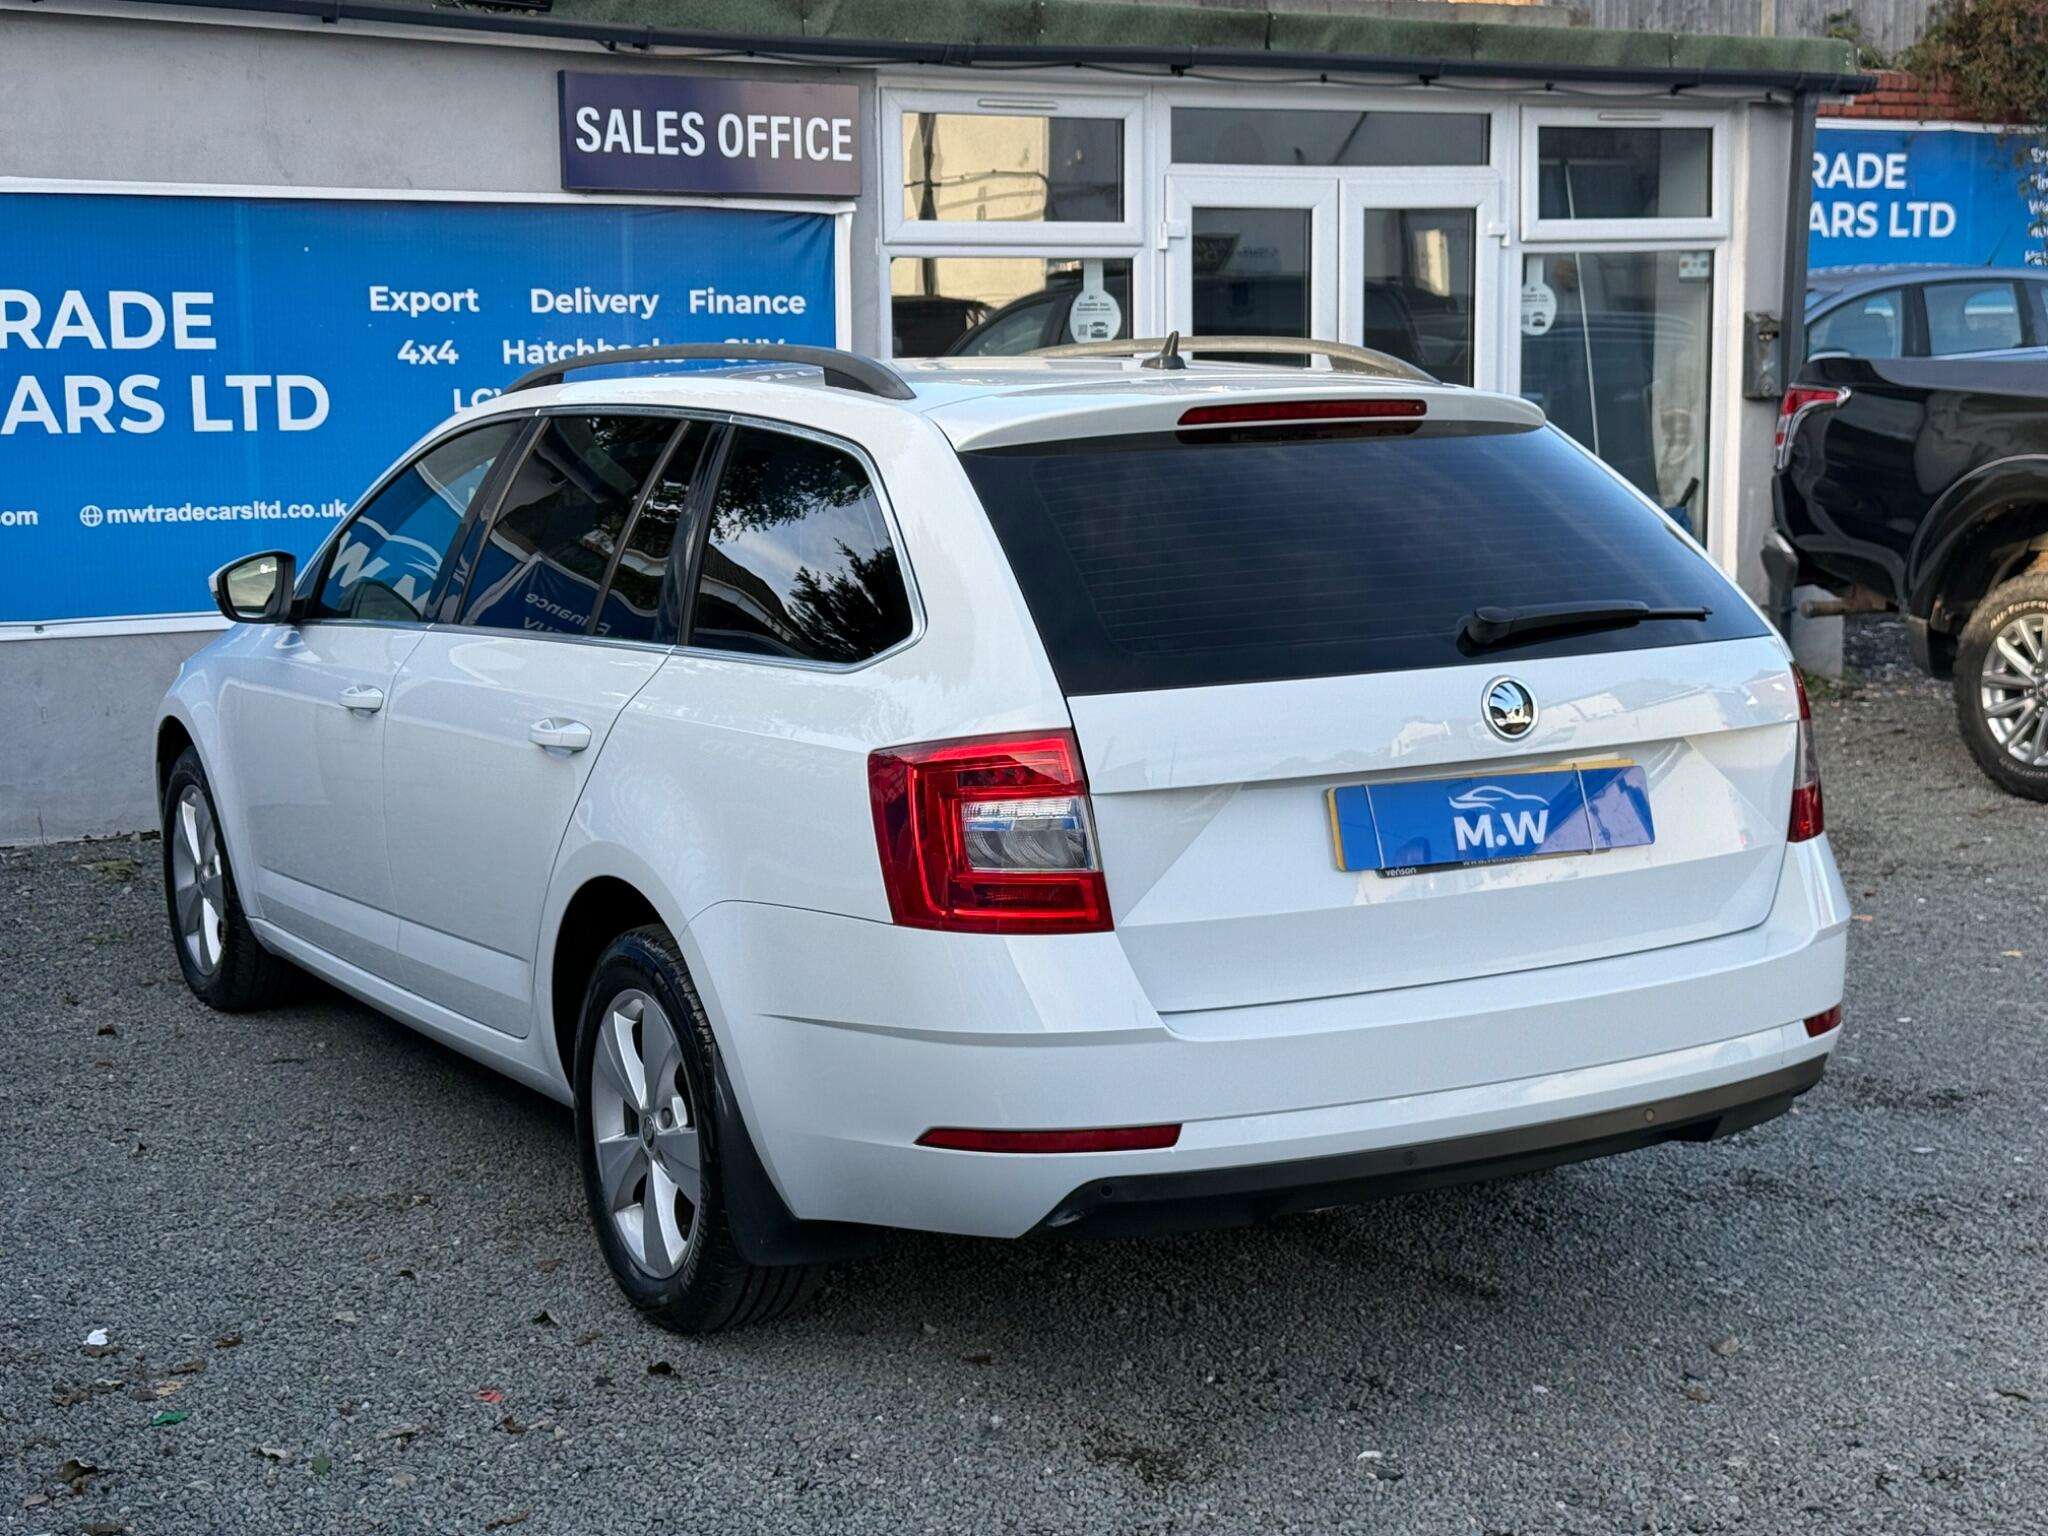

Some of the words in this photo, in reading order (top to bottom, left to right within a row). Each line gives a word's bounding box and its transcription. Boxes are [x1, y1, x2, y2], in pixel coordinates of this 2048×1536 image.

[576, 106, 706, 156] SALES
[717, 113, 853, 162] OFFICE
[1889, 202, 1957, 238] LTD
[369, 285, 480, 318] Export
[530, 286, 660, 320] Delivery
[689, 287, 806, 315] Finance
[0, 289, 217, 350] RADE
[397, 339, 459, 365] 4x4
[0, 374, 165, 435] ARS
[191, 374, 330, 432] LTD
[452, 387, 502, 415] LC
[106, 500, 348, 524] mwtradecarsltd.co.uk
[1453, 809, 1549, 851] M.W
